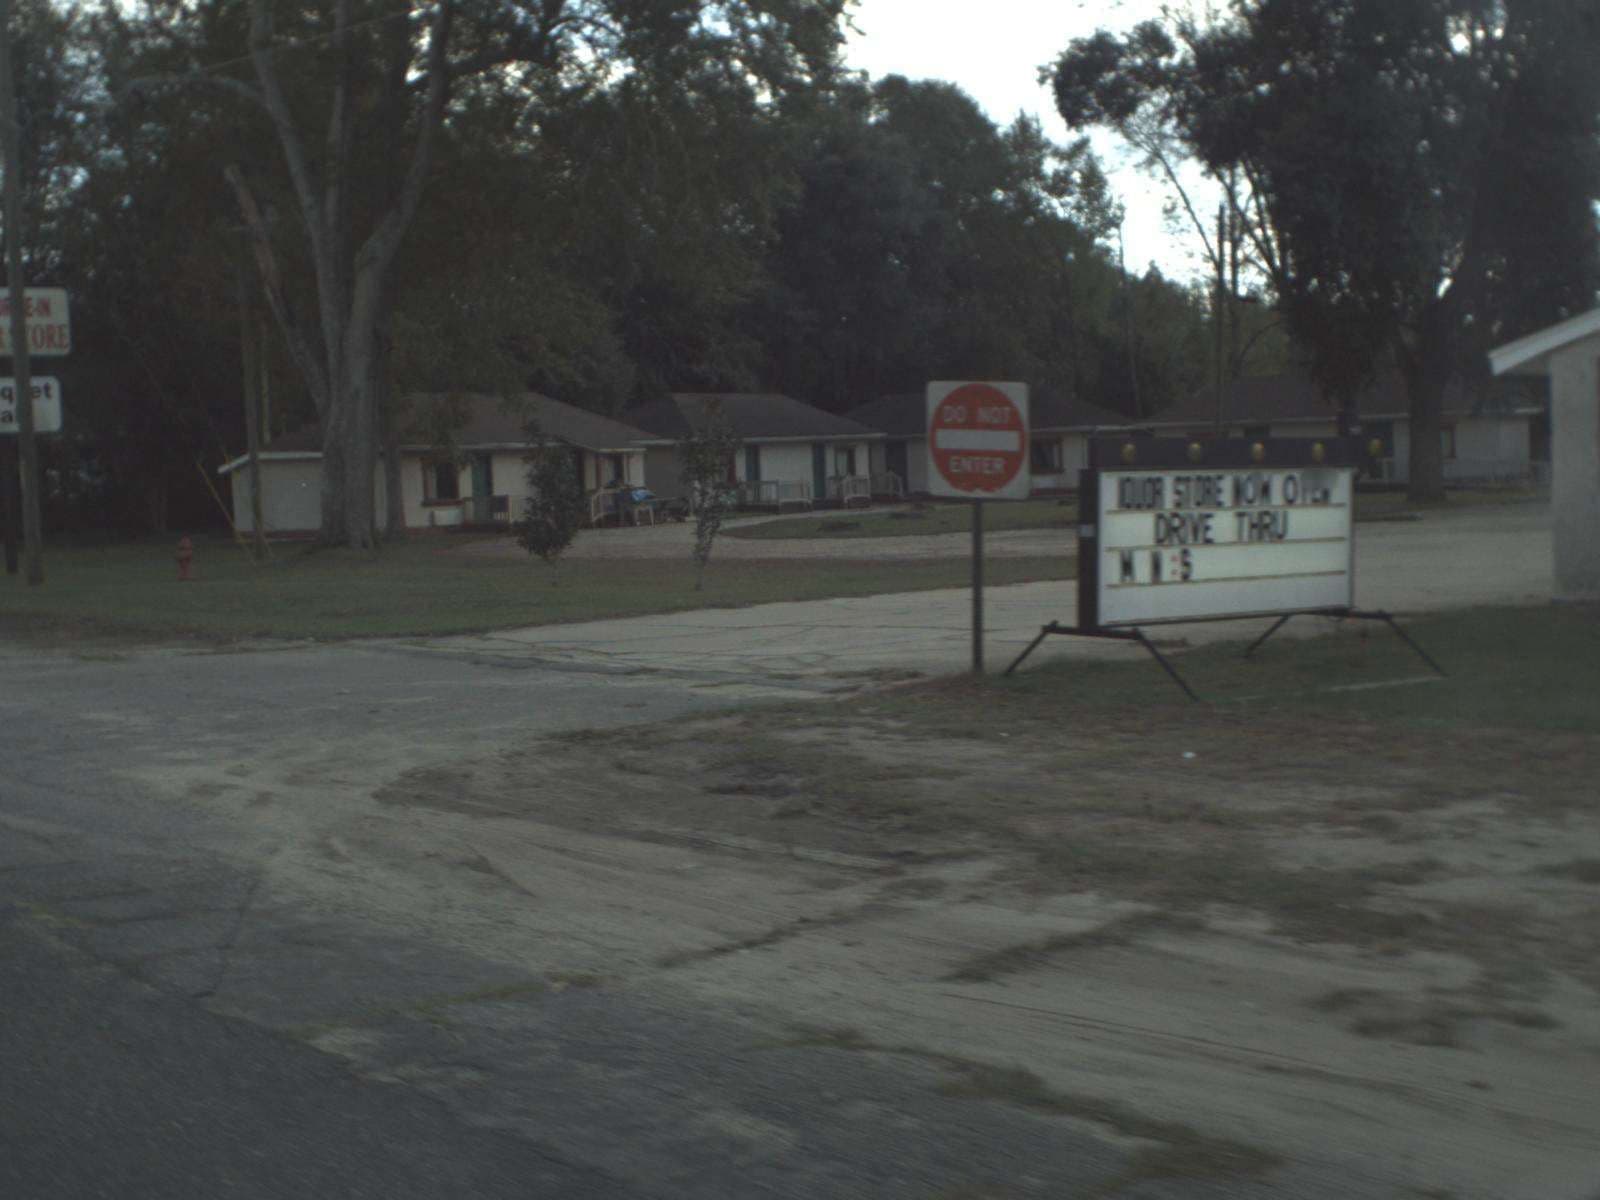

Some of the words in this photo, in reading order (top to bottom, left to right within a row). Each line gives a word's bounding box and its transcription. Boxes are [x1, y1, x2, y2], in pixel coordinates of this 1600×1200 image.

[943, 405, 967, 424] DO
[978, 406, 1011, 424] NOT
[949, 456, 1005, 474] ENTER
[1173, 475, 1224, 508] STORE
[1154, 512, 1214, 545] DRIVE
[1236, 510, 1289, 542] THRU
